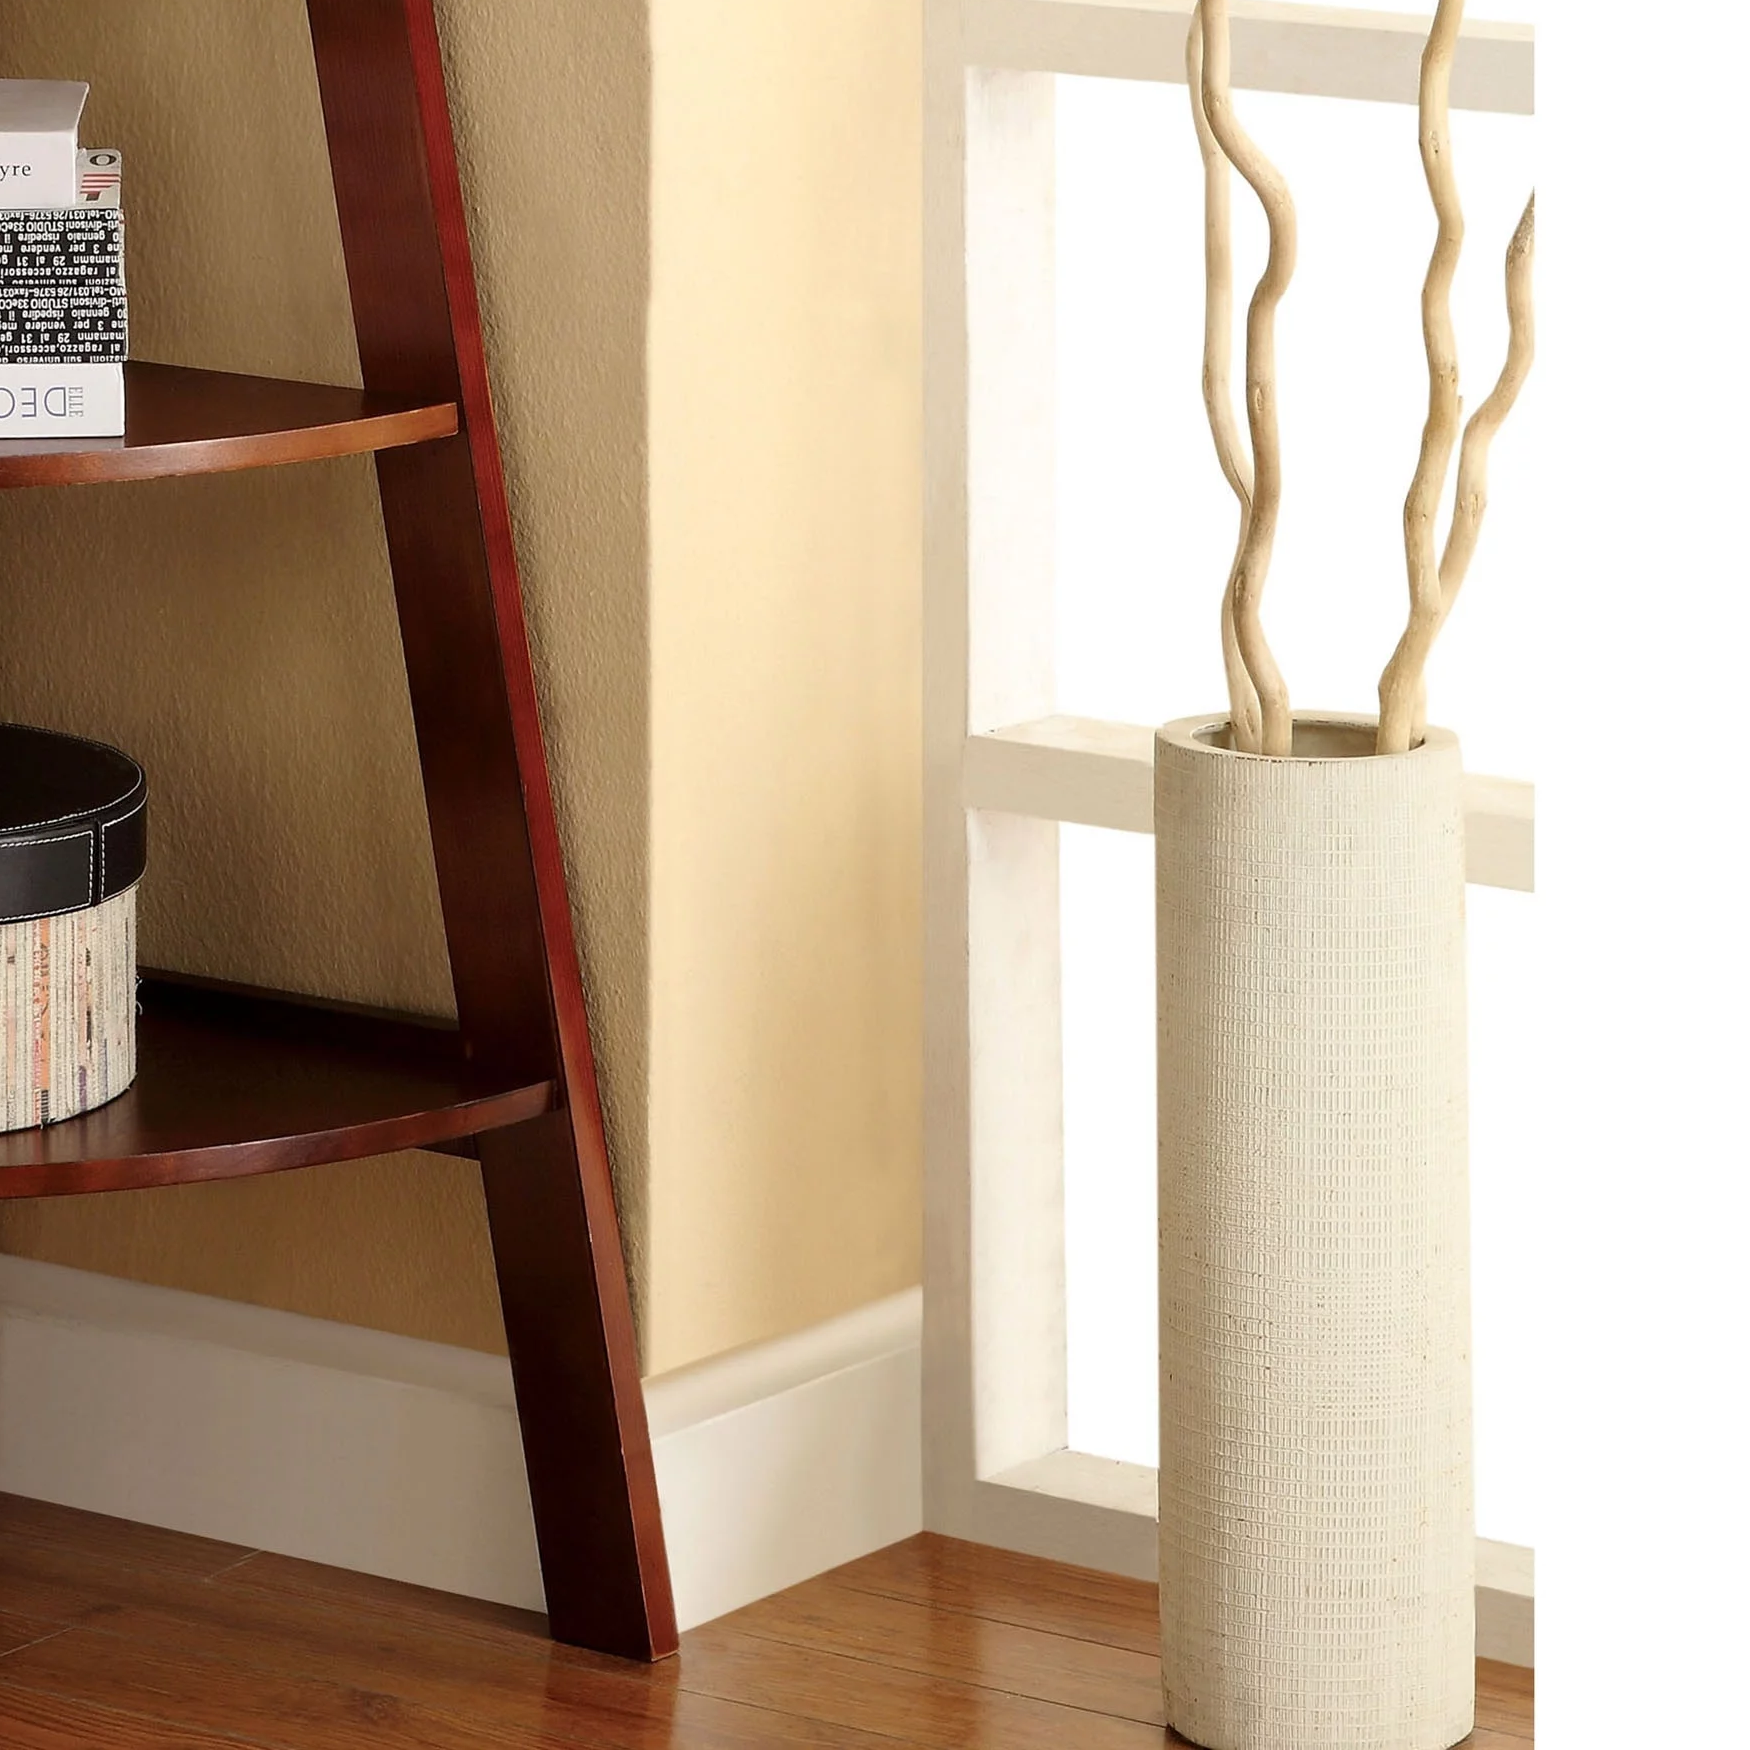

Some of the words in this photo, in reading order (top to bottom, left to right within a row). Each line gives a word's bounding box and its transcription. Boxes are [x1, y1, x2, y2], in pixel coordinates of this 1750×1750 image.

[26, 222, 64, 232] STUDIO
[5, 234, 10, 243] il
[18, 231, 59, 243] rispedire
[67, 231, 105, 243] gennaio
[21, 244, 61, 254] vendere
[69, 242, 85, 252] per
[93, 244, 99, 254] 3
[16, 256, 28, 266] 31
[36, 256, 45, 266] al
[53, 256, 65, 266] 29
[30, 298, 68, 309] STUDIO
[9, 311, 15, 320] il
[22, 308, 64, 320] rispedire
[71, 308, 109, 319] gennaio
[25, 321, 65, 331] vendere
[73, 319, 89, 329] per
[98, 321, 104, 331] 3
[21, 333, 32, 343] 31
[41, 333, 50, 343] al
[58, 333, 70, 343] 29
[68, 386, 84, 418] ELLE
